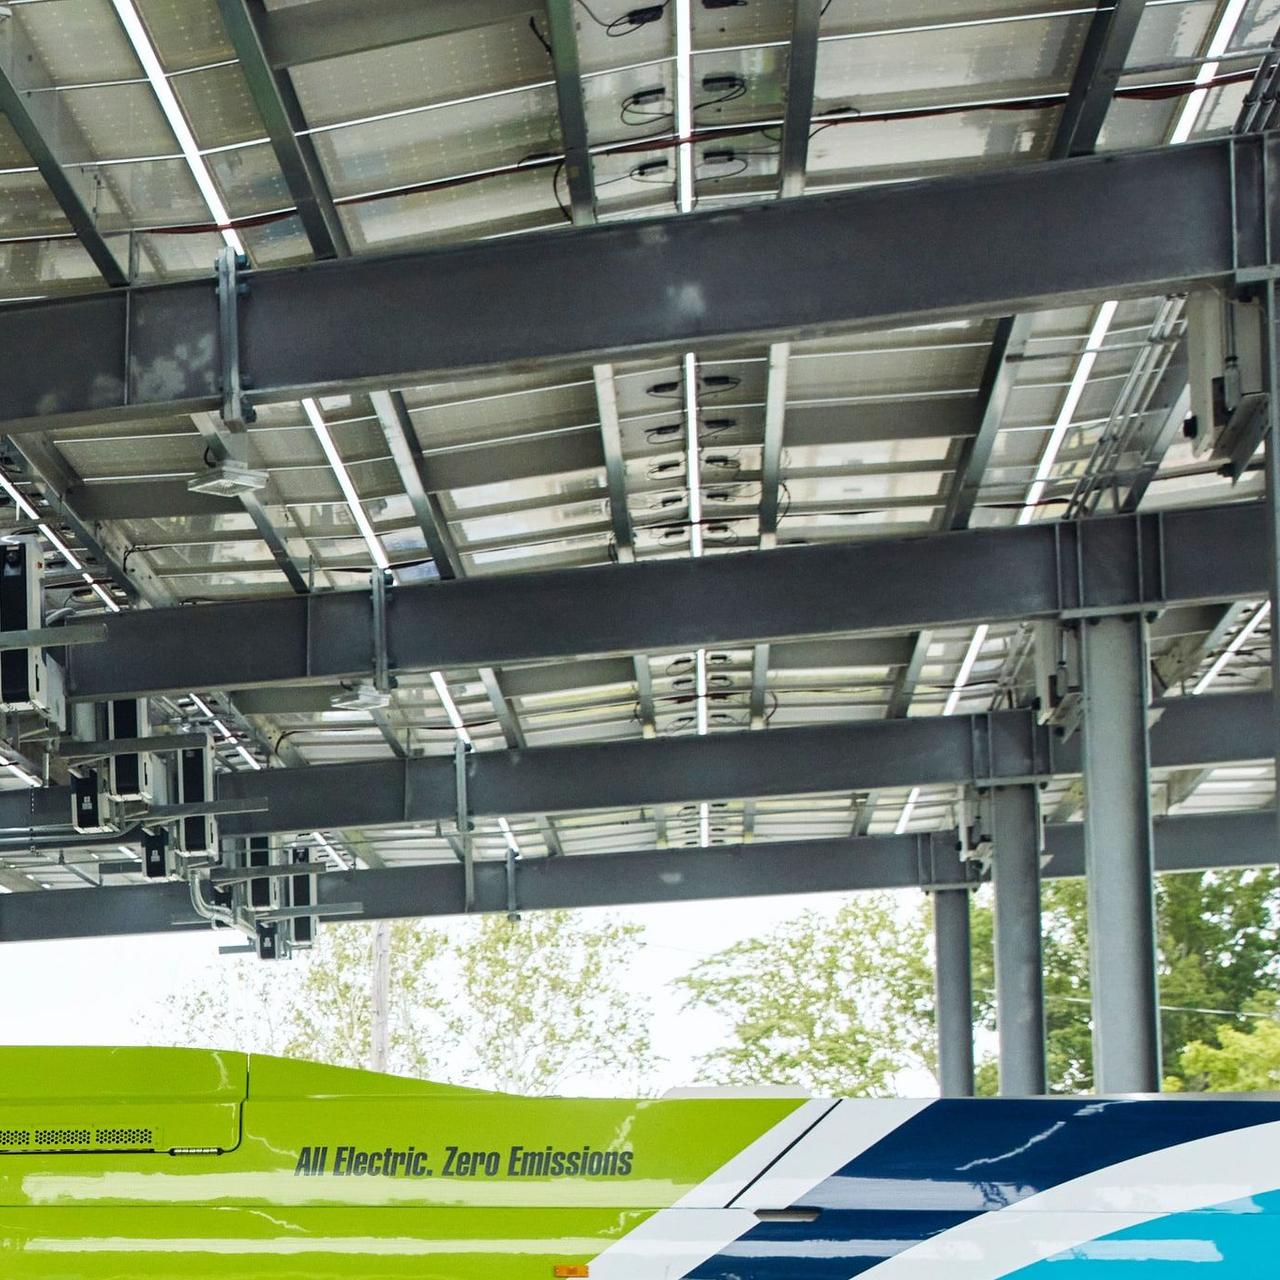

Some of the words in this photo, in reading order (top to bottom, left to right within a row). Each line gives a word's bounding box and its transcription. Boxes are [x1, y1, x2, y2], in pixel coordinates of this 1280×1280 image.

[294, 1146, 328, 1176] All
[333, 1146, 433, 1176] Electric.
[441, 1146, 500, 1176] Zero
[507, 1146, 634, 1176] Emissions
